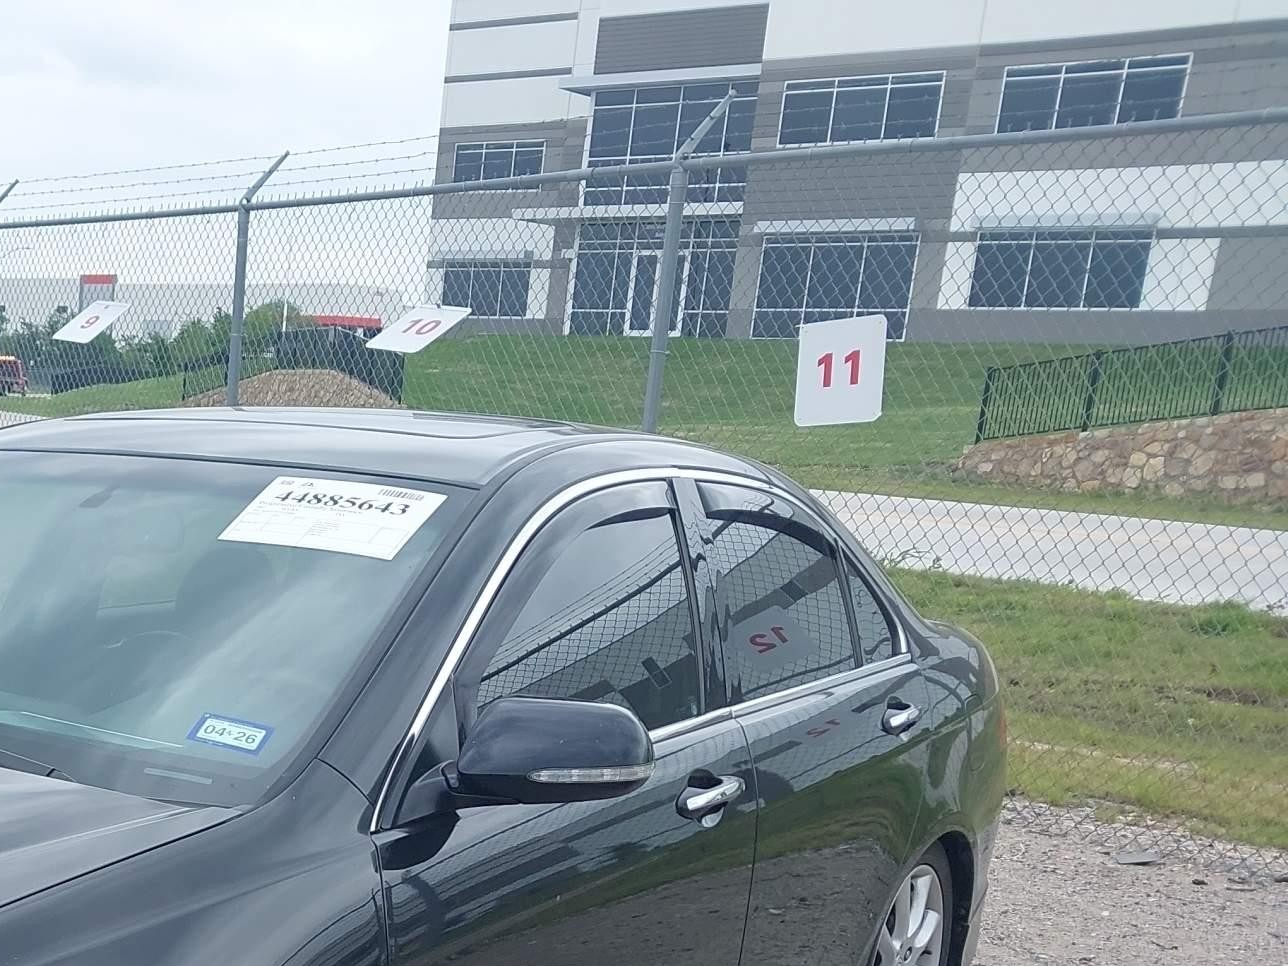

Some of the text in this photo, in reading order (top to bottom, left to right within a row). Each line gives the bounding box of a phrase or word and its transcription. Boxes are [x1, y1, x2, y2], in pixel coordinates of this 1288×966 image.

[80, 315, 100, 329] 9
[401, 318, 442, 335] 10
[817, 349, 860, 388] 11
[274, 490, 411, 516] 44885643
